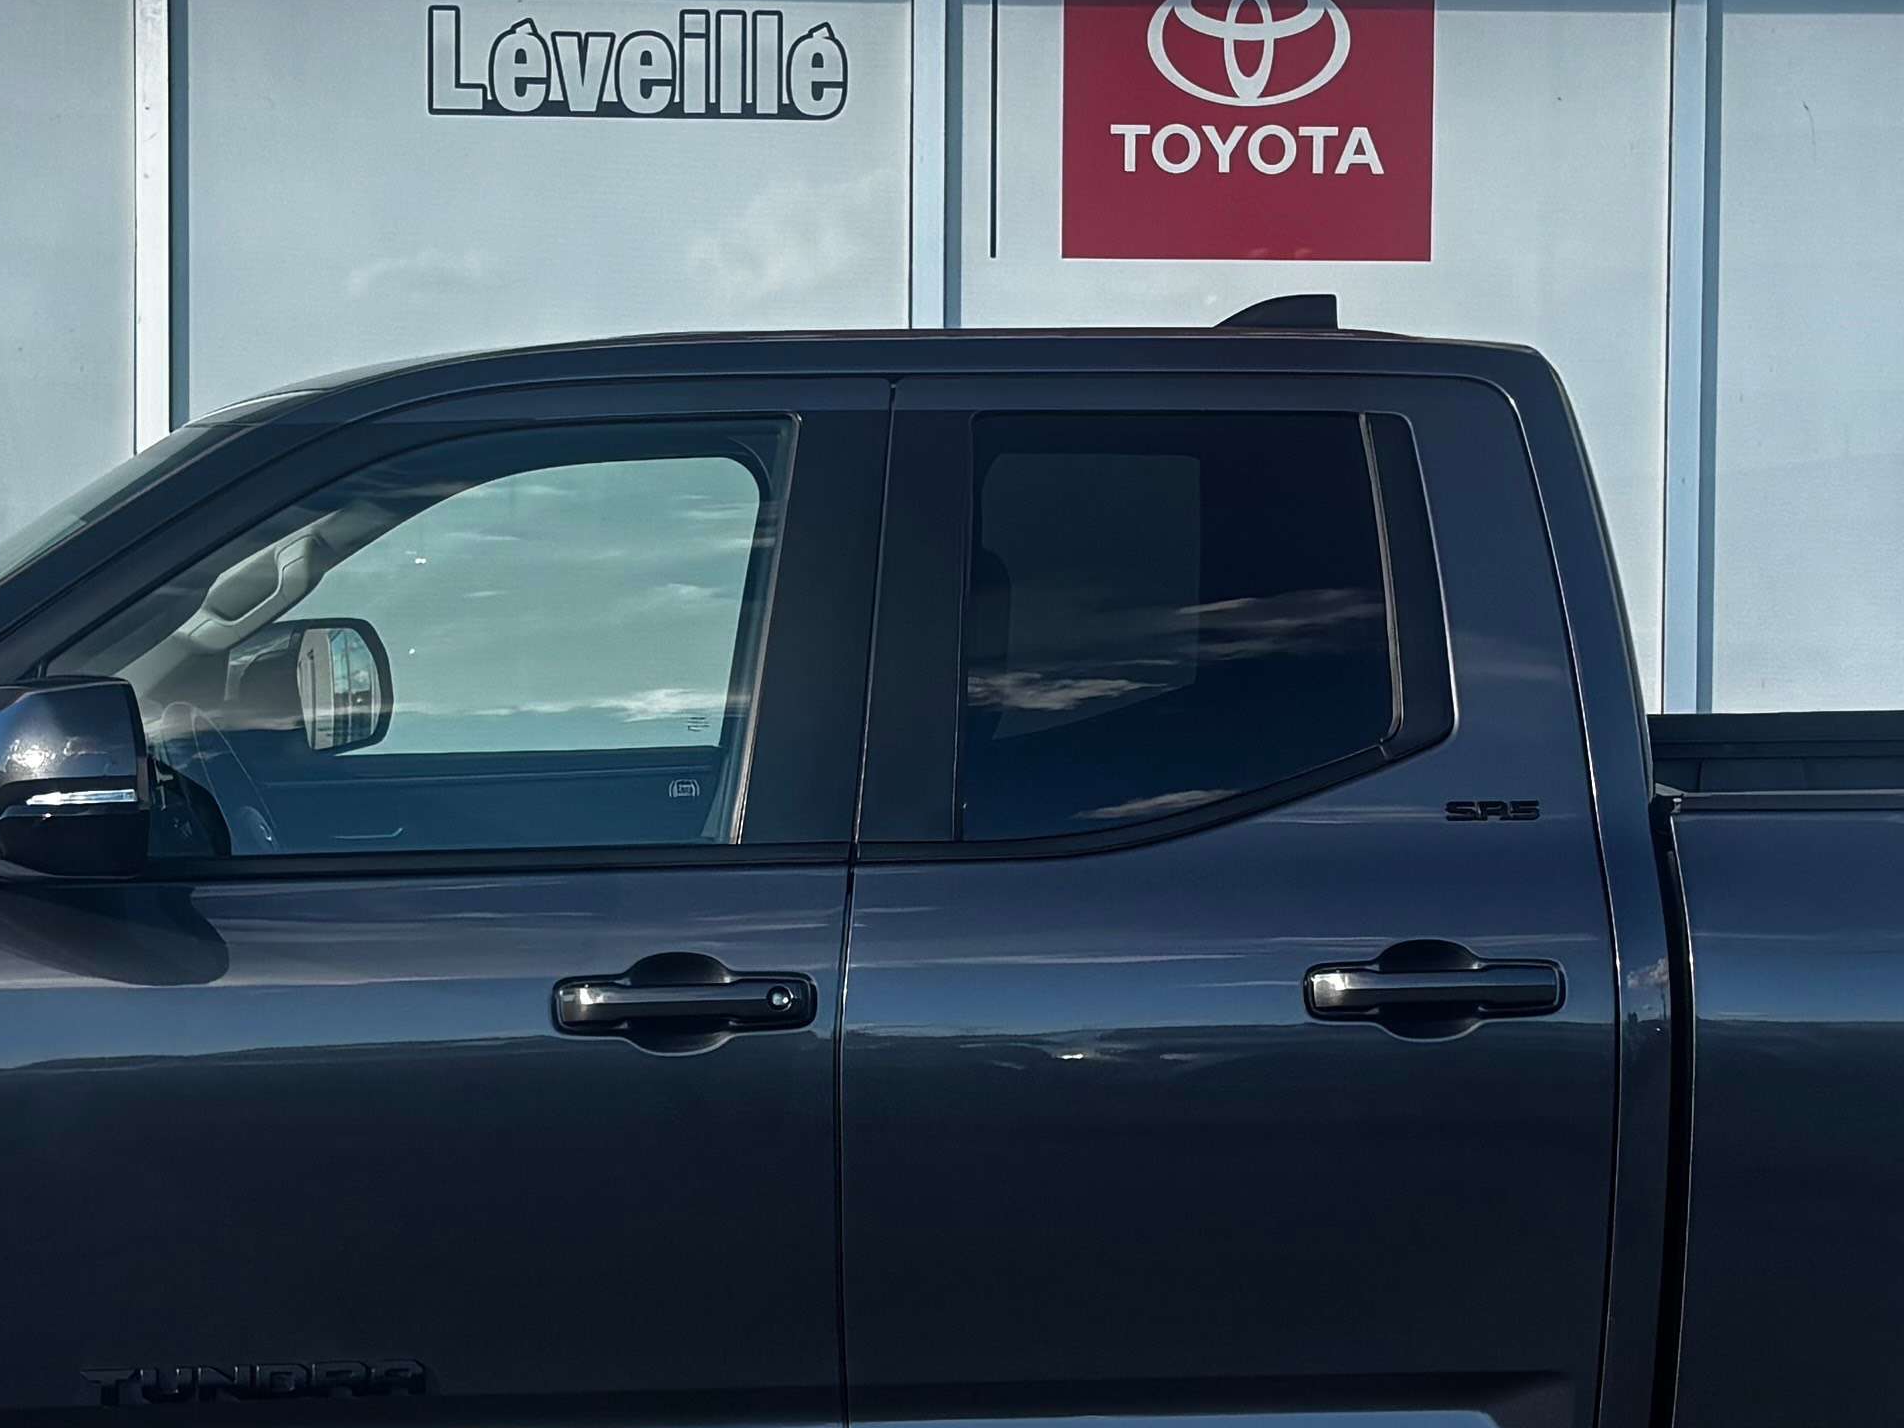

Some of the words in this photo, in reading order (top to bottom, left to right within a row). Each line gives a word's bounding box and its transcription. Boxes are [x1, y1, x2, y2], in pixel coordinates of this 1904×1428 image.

[427, 4, 848, 121] Léveillé
[1110, 123, 1385, 175] TOYOTA
[1445, 799, 1540, 821] SR5
[80, 1358, 437, 1405] TUNDRA
